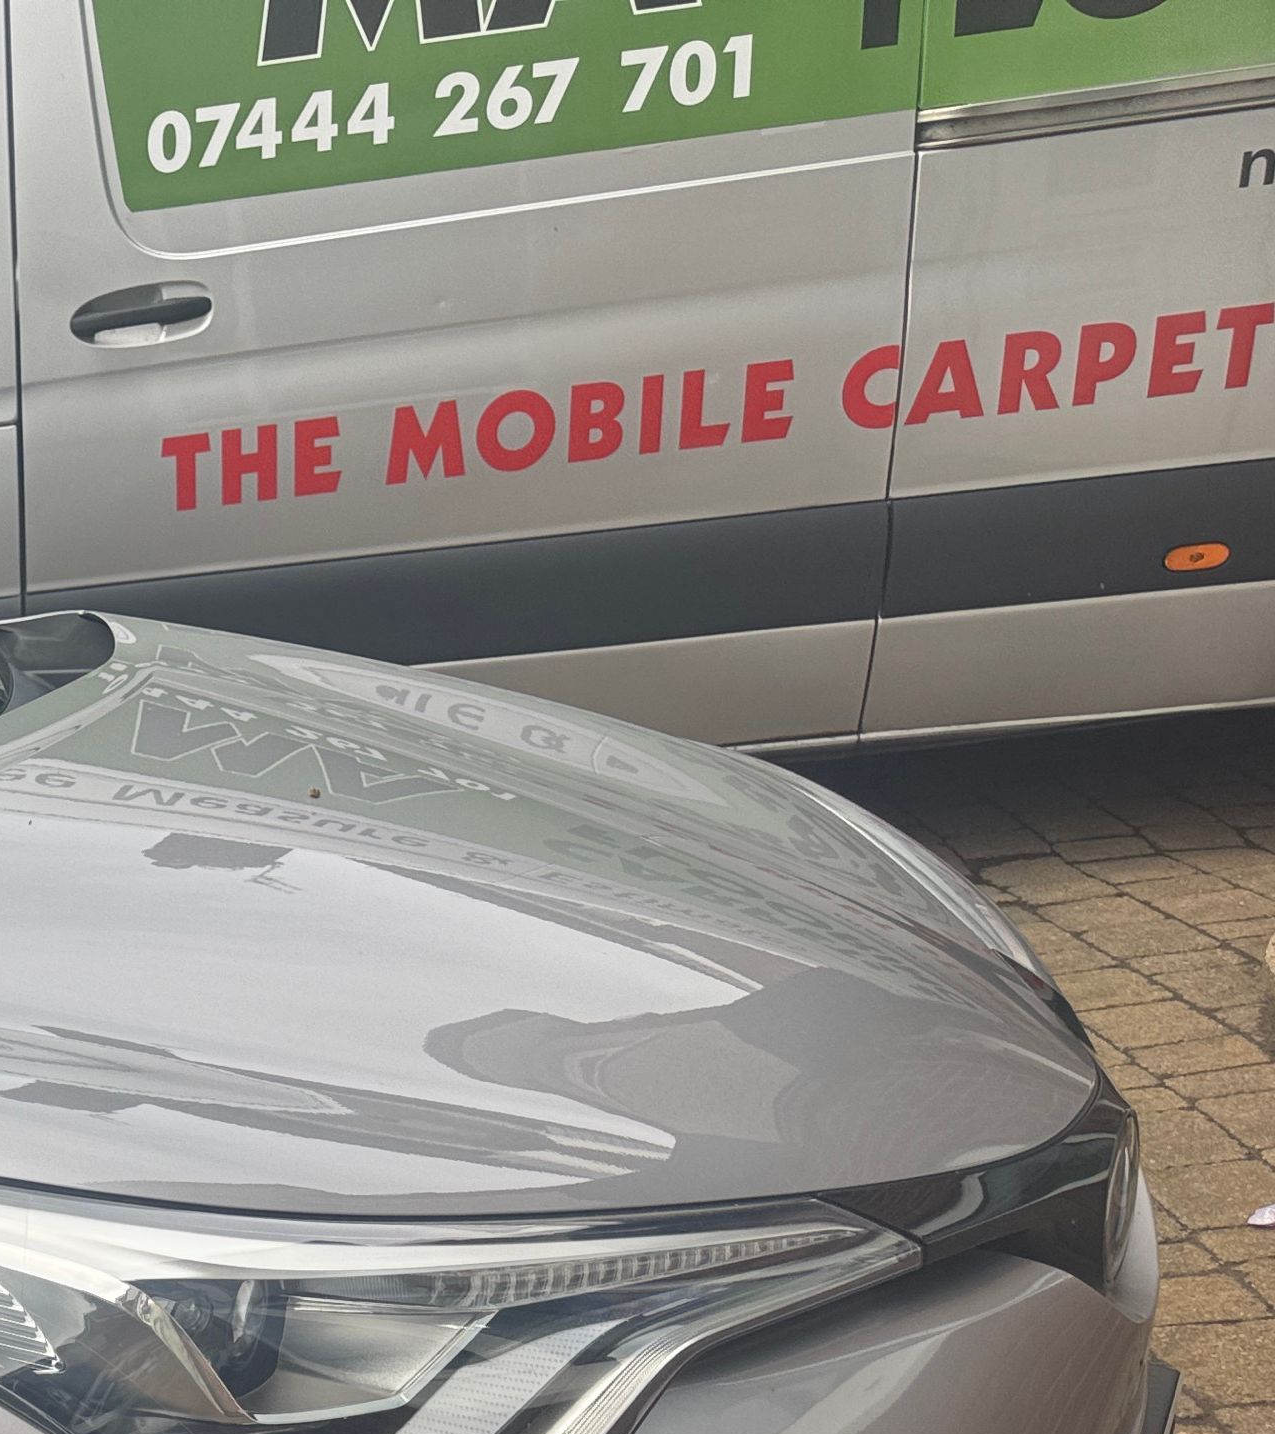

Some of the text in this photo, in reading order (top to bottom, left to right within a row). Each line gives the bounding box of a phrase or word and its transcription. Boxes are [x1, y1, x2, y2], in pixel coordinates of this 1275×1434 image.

[147, 82, 395, 174] 07444
[433, 57, 580, 138] 267
[620, 34, 754, 114] 701
[162, 302, 1275, 511] THE MOBILE CARPET
